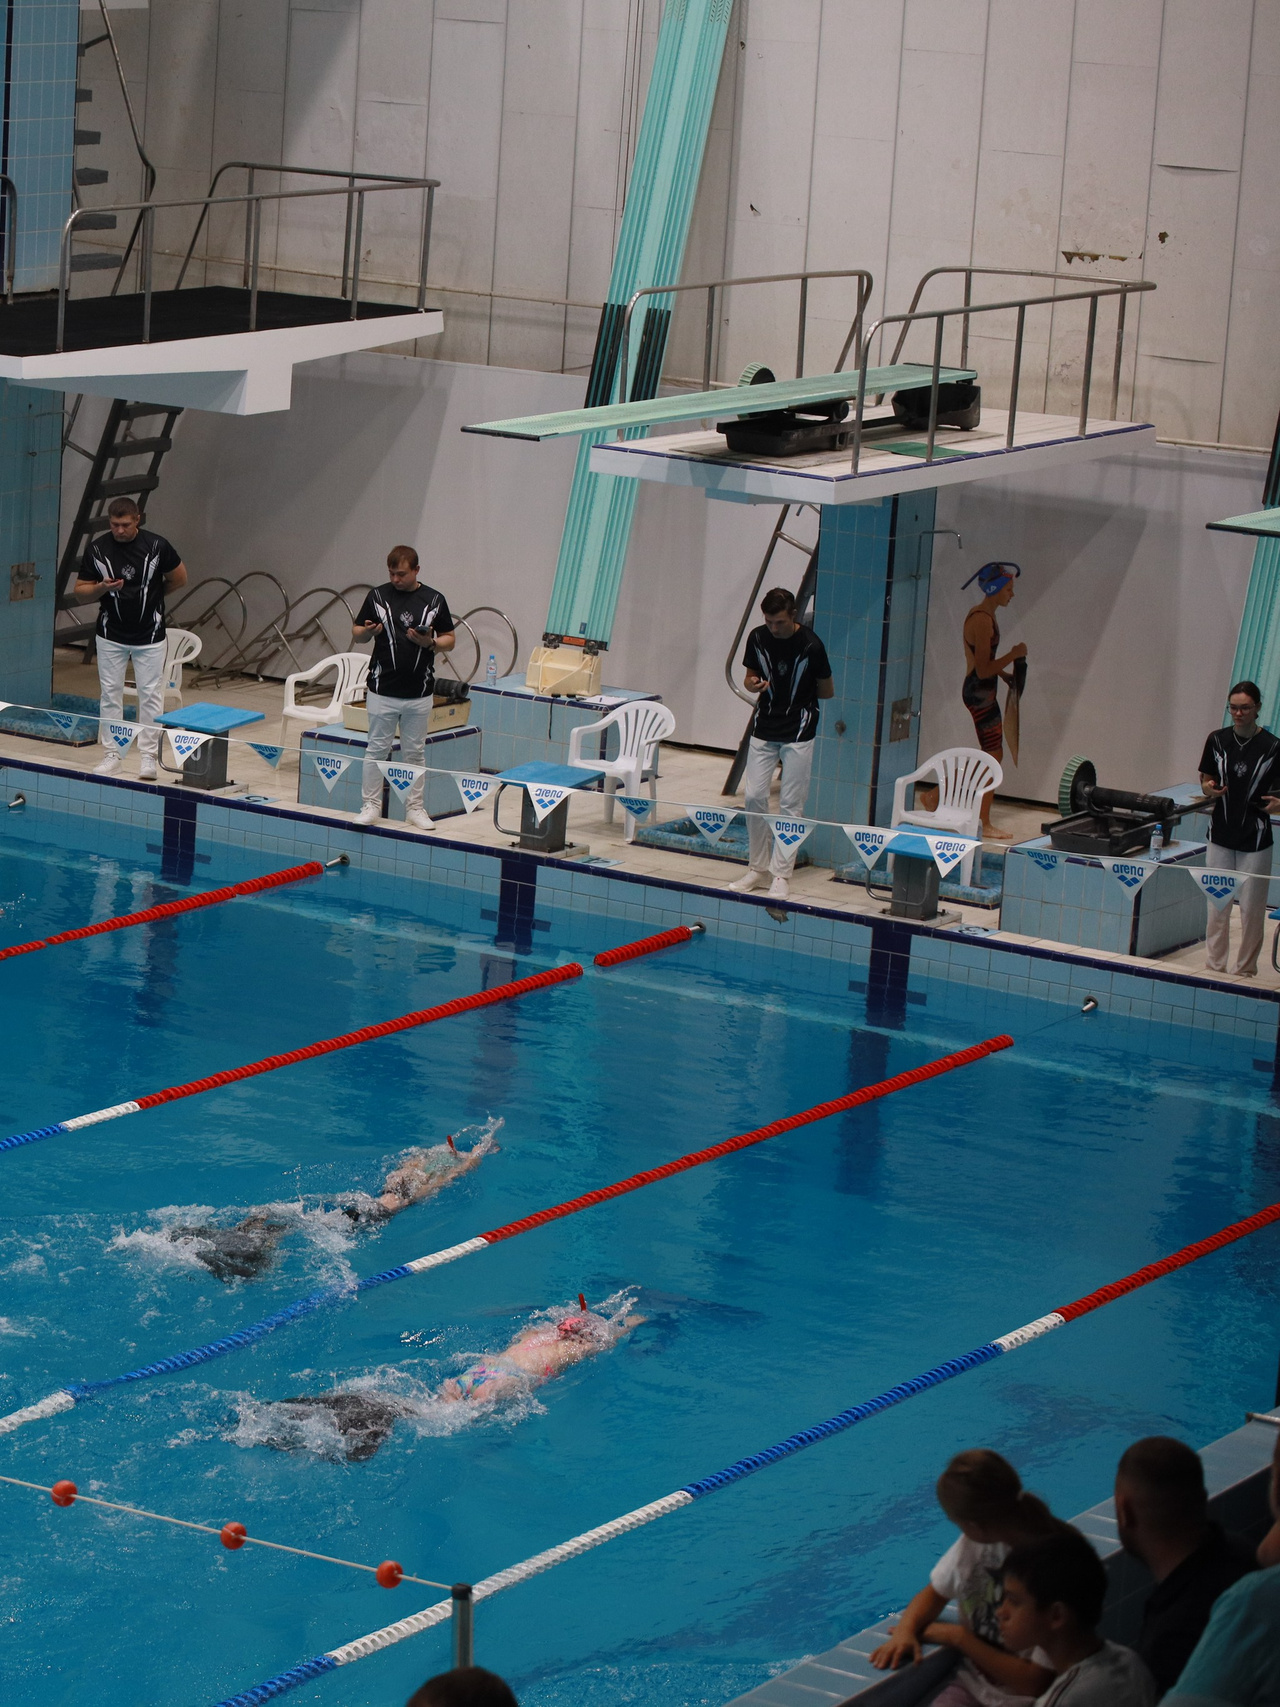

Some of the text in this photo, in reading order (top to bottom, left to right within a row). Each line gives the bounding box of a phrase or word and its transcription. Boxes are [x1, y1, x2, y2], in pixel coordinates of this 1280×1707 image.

[110, 724, 133, 737] arena
[174, 734, 200, 745] arena
[317, 756, 342, 770] arena
[387, 767, 414, 780] arena
[461, 778, 489, 792] arena
[535, 788, 564, 799] arena
[695, 810, 726, 823] arena
[775, 820, 805, 834] arena
[854, 830, 884, 844] arena
[935, 840, 966, 852] arena
[1027, 851, 1058, 864] arena
[1112, 863, 1144, 877] arena
[1201, 873, 1235, 887] arena
